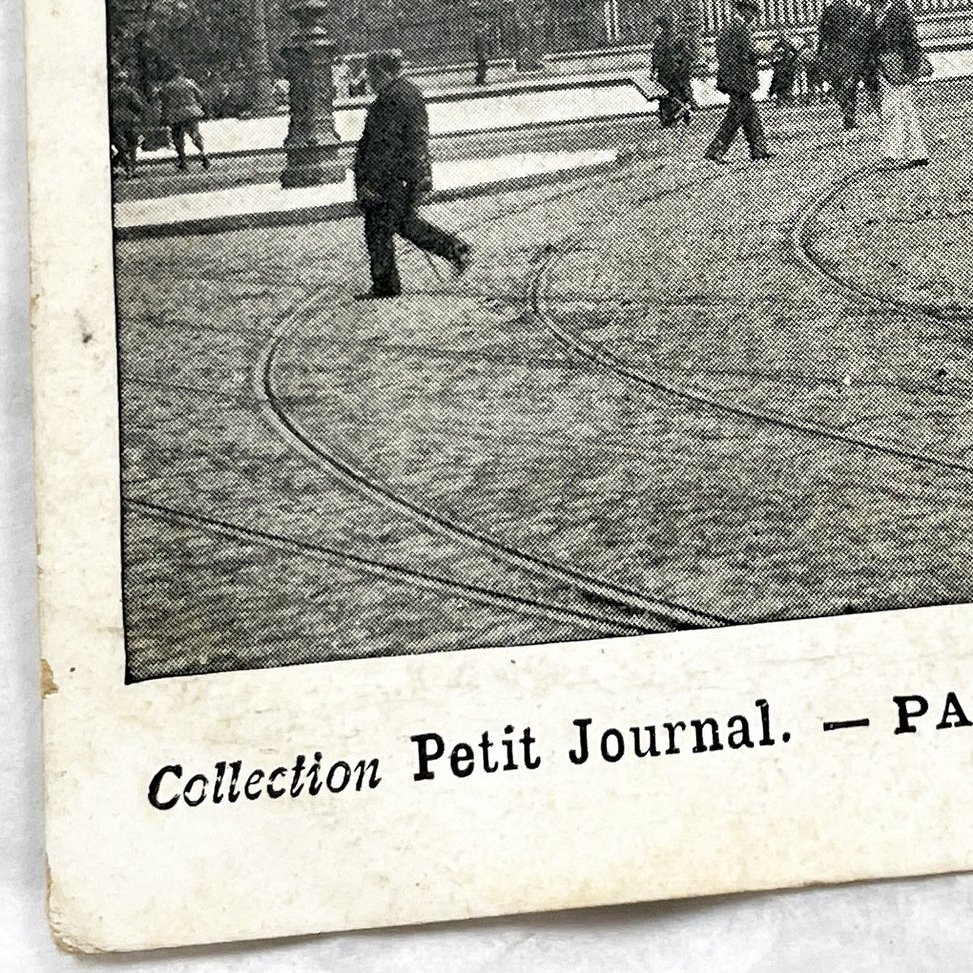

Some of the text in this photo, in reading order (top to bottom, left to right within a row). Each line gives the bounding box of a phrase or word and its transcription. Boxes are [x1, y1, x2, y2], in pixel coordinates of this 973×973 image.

[147, 751, 383, 811] Collection
[410, 724, 542, 782] Petit
[567, 698, 792, 765] Journal.
